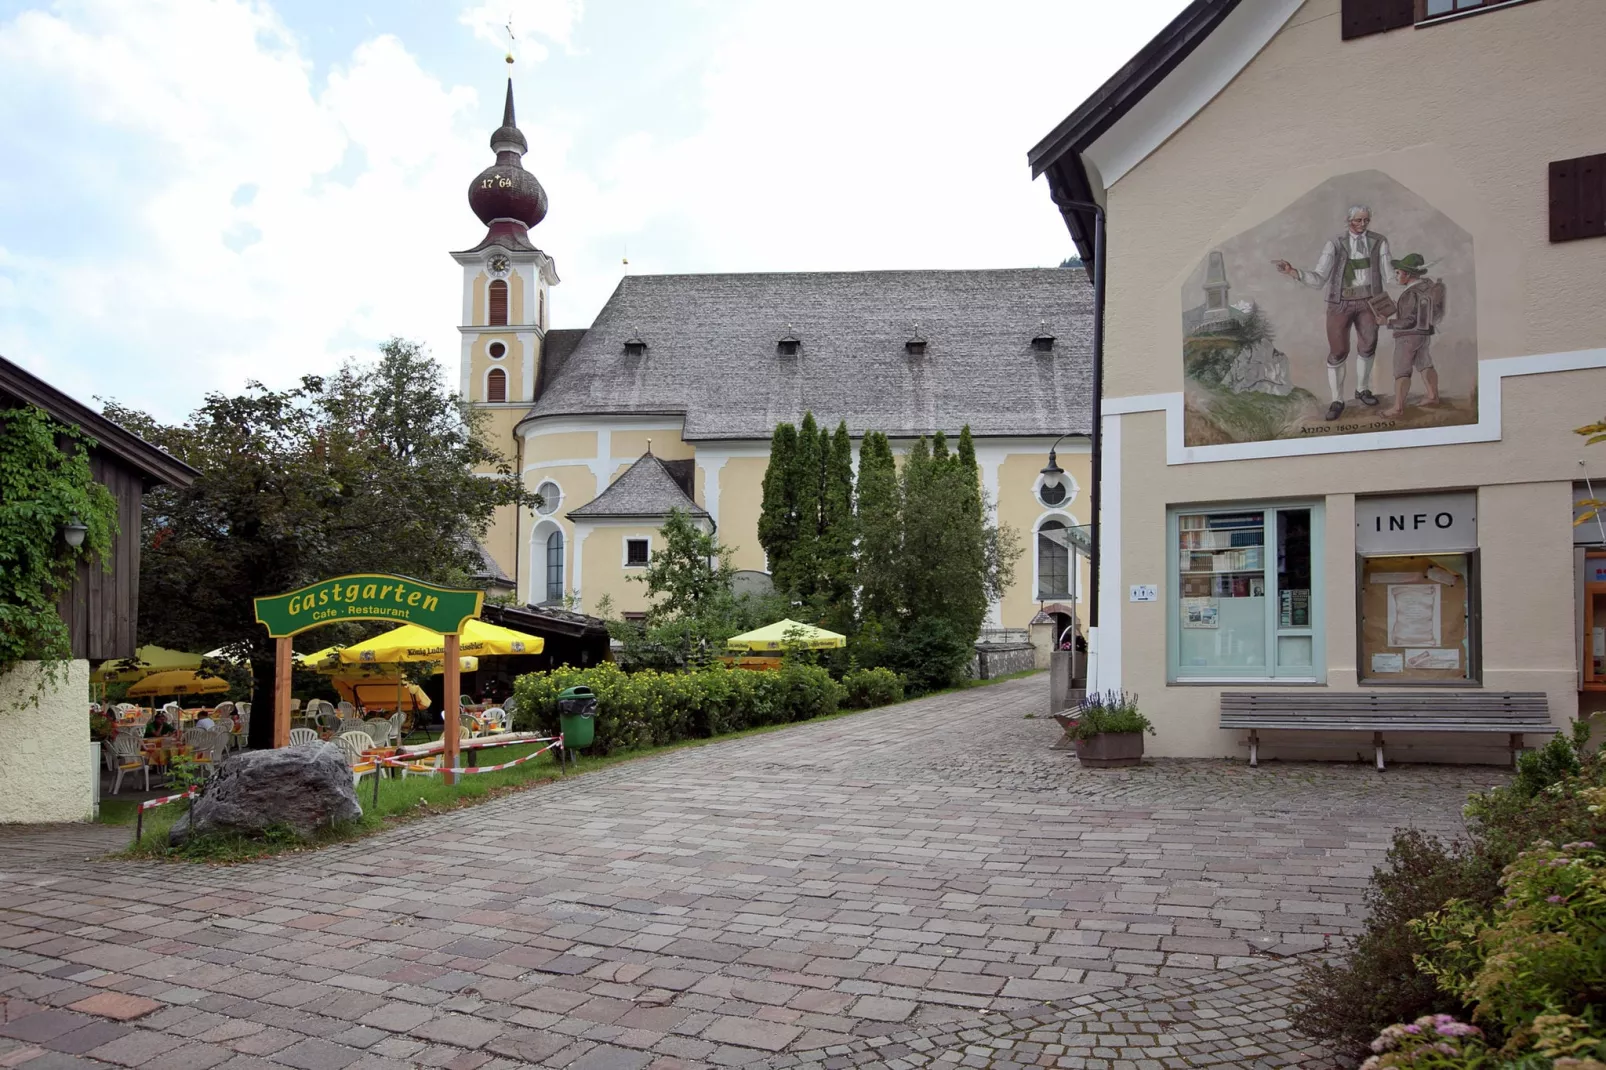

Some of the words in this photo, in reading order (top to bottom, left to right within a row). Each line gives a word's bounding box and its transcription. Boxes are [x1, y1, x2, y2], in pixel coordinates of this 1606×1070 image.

[481, 179, 493, 188] 17
[1375, 512, 1454, 532] INFO
[288, 583, 439, 616] Gastgarten
[312, 608, 337, 621] Cafe
[348, 605, 410, 619] Restaurant
